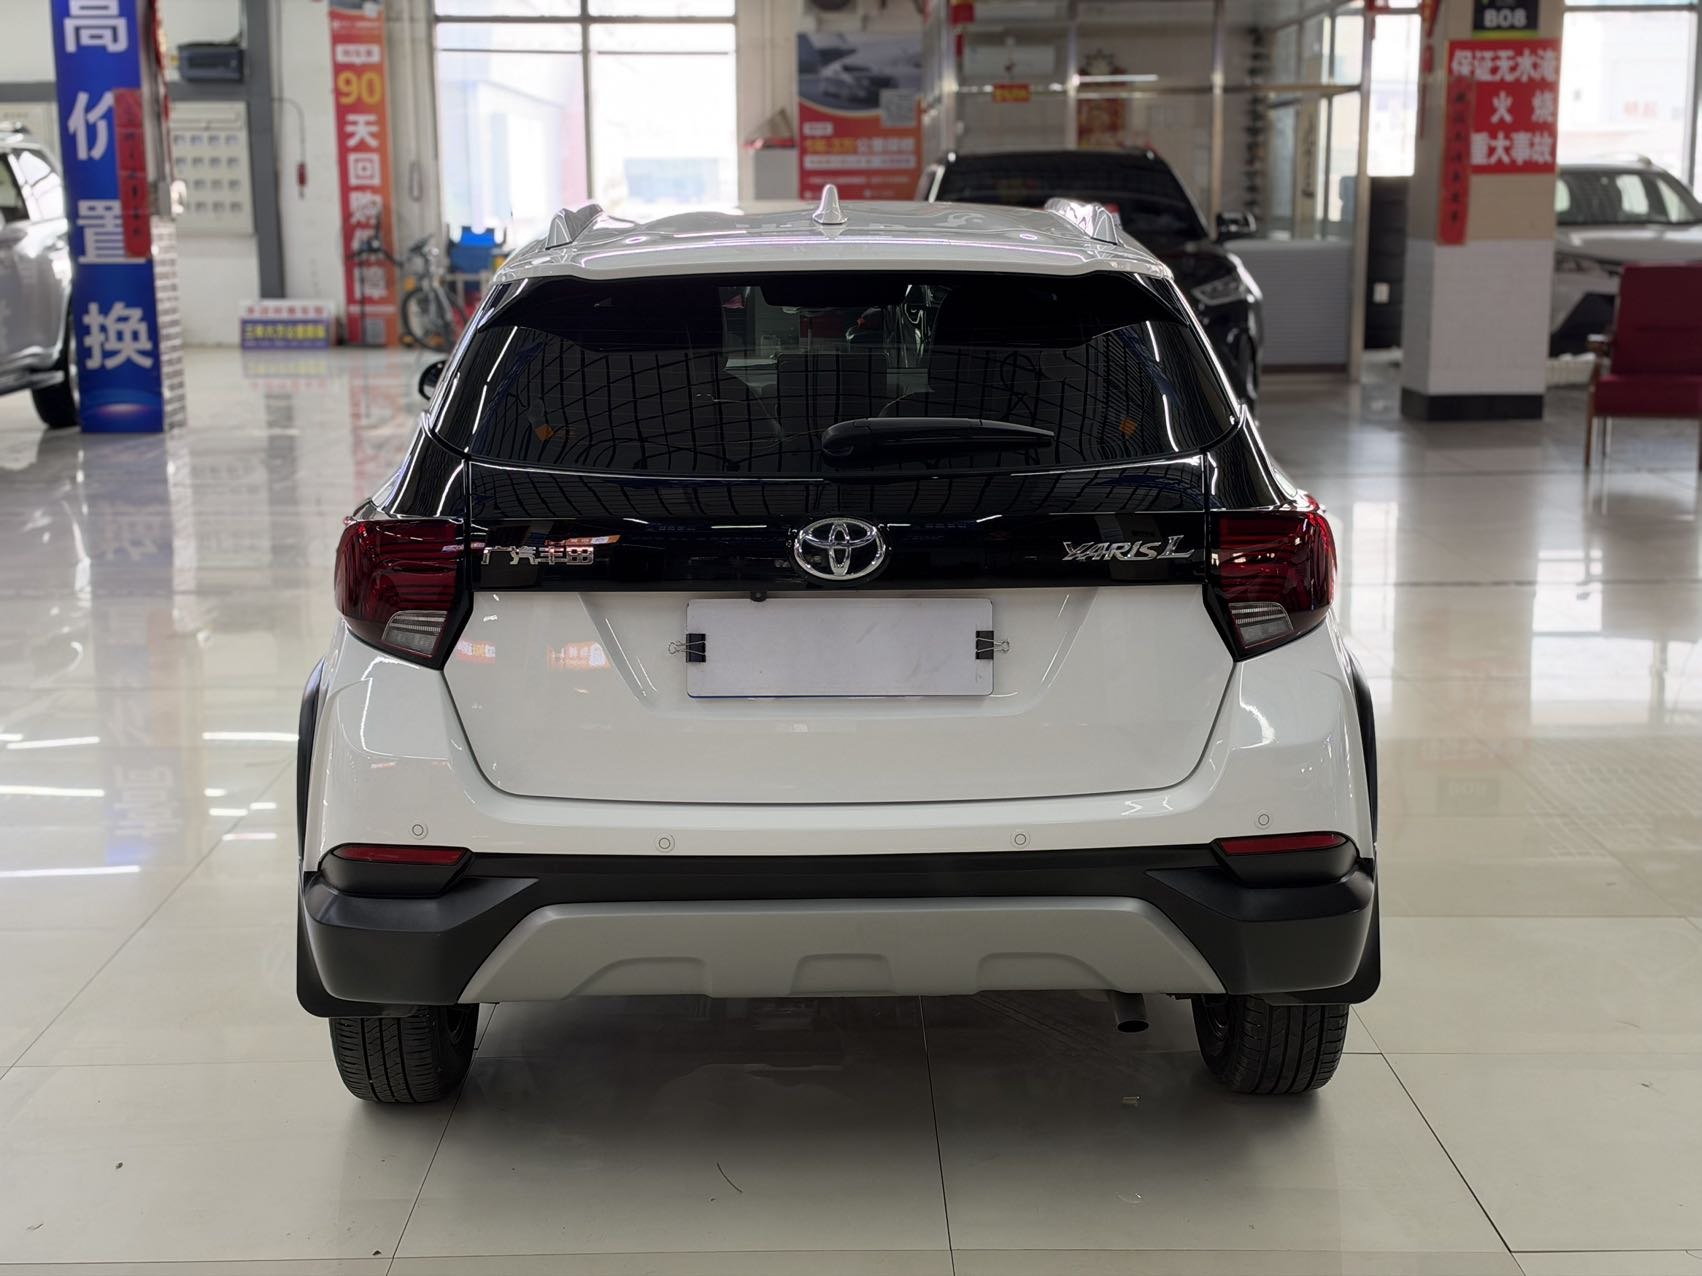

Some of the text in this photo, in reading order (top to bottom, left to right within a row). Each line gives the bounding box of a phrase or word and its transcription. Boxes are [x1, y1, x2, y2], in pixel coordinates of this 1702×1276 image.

[1484, 8, 1527, 28] B08
[337, 71, 382, 105] 90
[1471, 131, 1553, 166] 重大事故
[64, 0, 154, 370] 高价置换
[1062, 541, 1162, 561] YARIS
